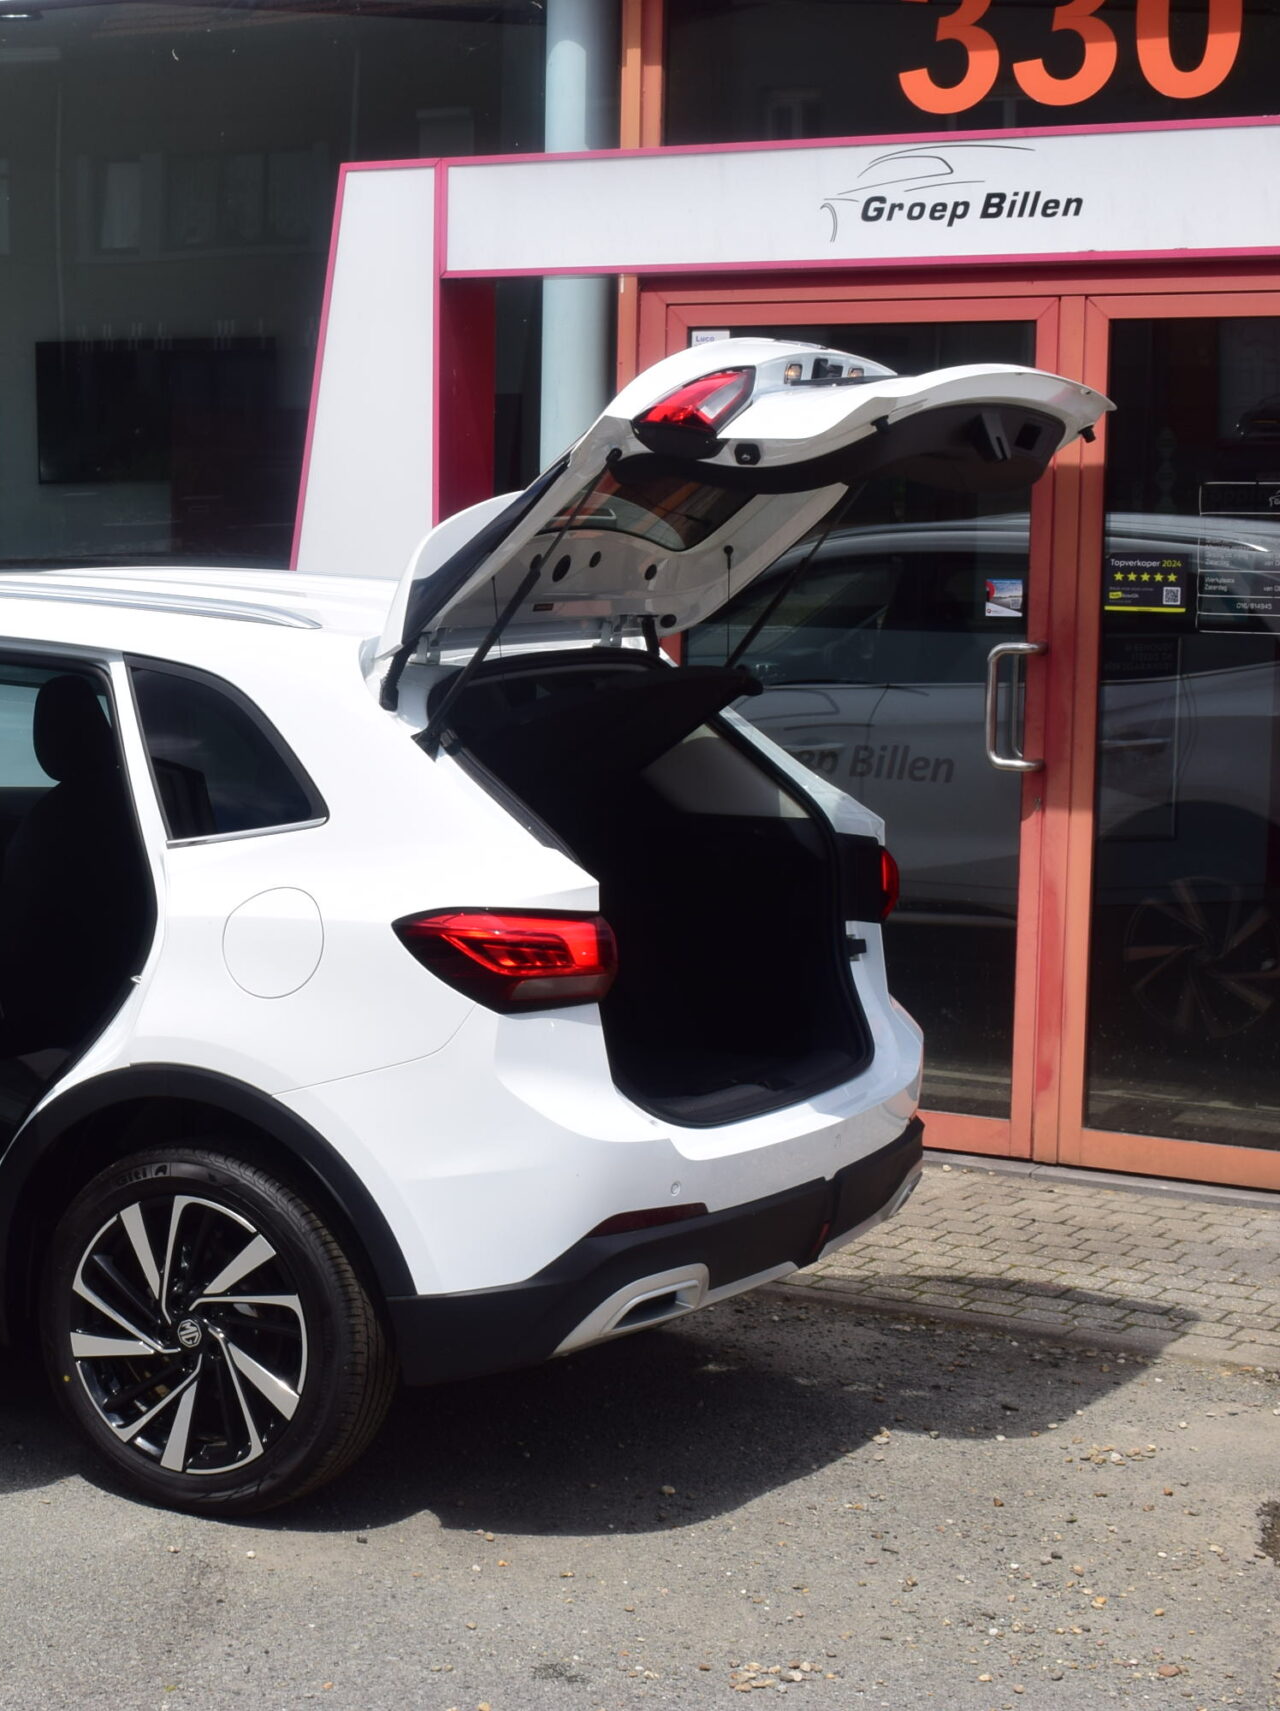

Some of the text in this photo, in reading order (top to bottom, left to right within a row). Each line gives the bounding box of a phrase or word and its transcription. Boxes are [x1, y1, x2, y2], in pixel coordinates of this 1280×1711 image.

[898, 0, 1243, 115] 330
[860, 190, 1084, 227] Groep Billen
[1110, 558, 1182, 568] Topverkoper 2024
[849, 744, 955, 783] Billen
